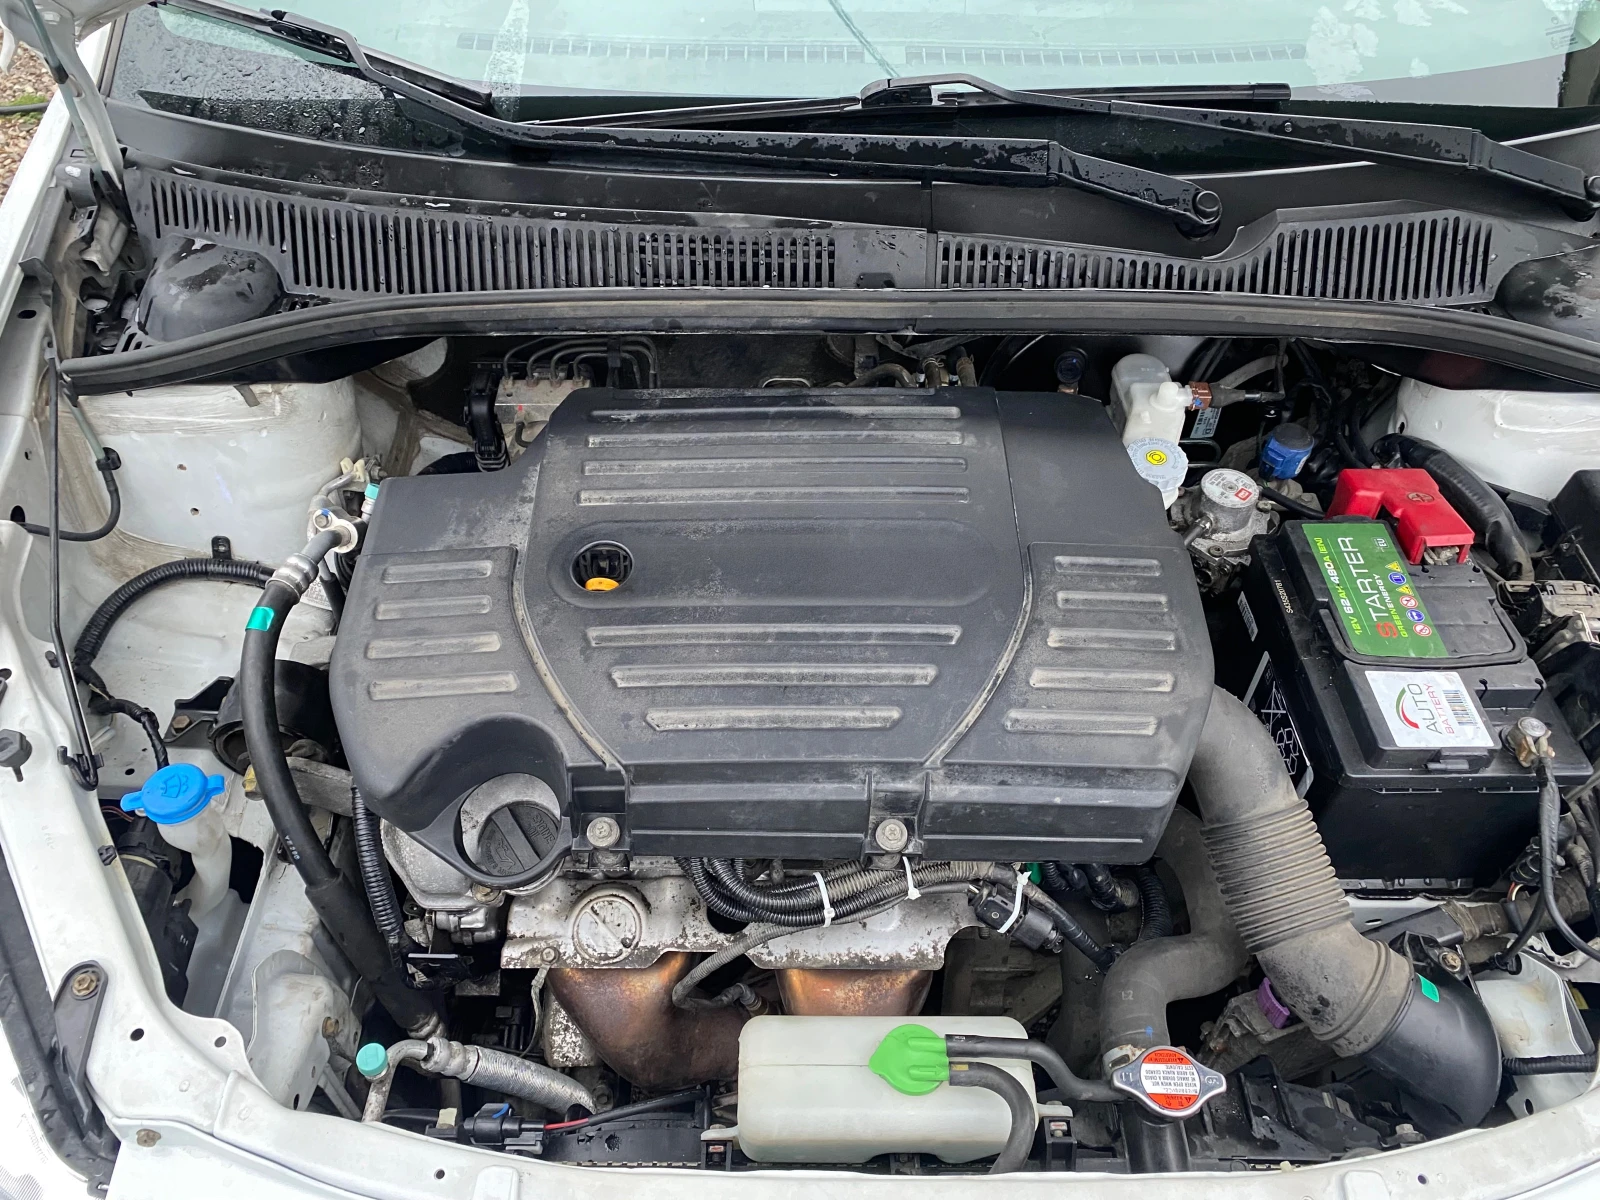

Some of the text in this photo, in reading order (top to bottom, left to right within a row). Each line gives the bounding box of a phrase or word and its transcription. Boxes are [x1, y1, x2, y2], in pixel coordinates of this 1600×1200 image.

[1314, 538, 1328, 554] (EN)
[1337, 537, 1398, 638] STARTER
[1348, 616, 1362, 636] 12V
[1406, 683, 1443, 735] AUTO
[1424, 682, 1454, 734] BATTERY
[533, 814, 556, 844] ENGINE
